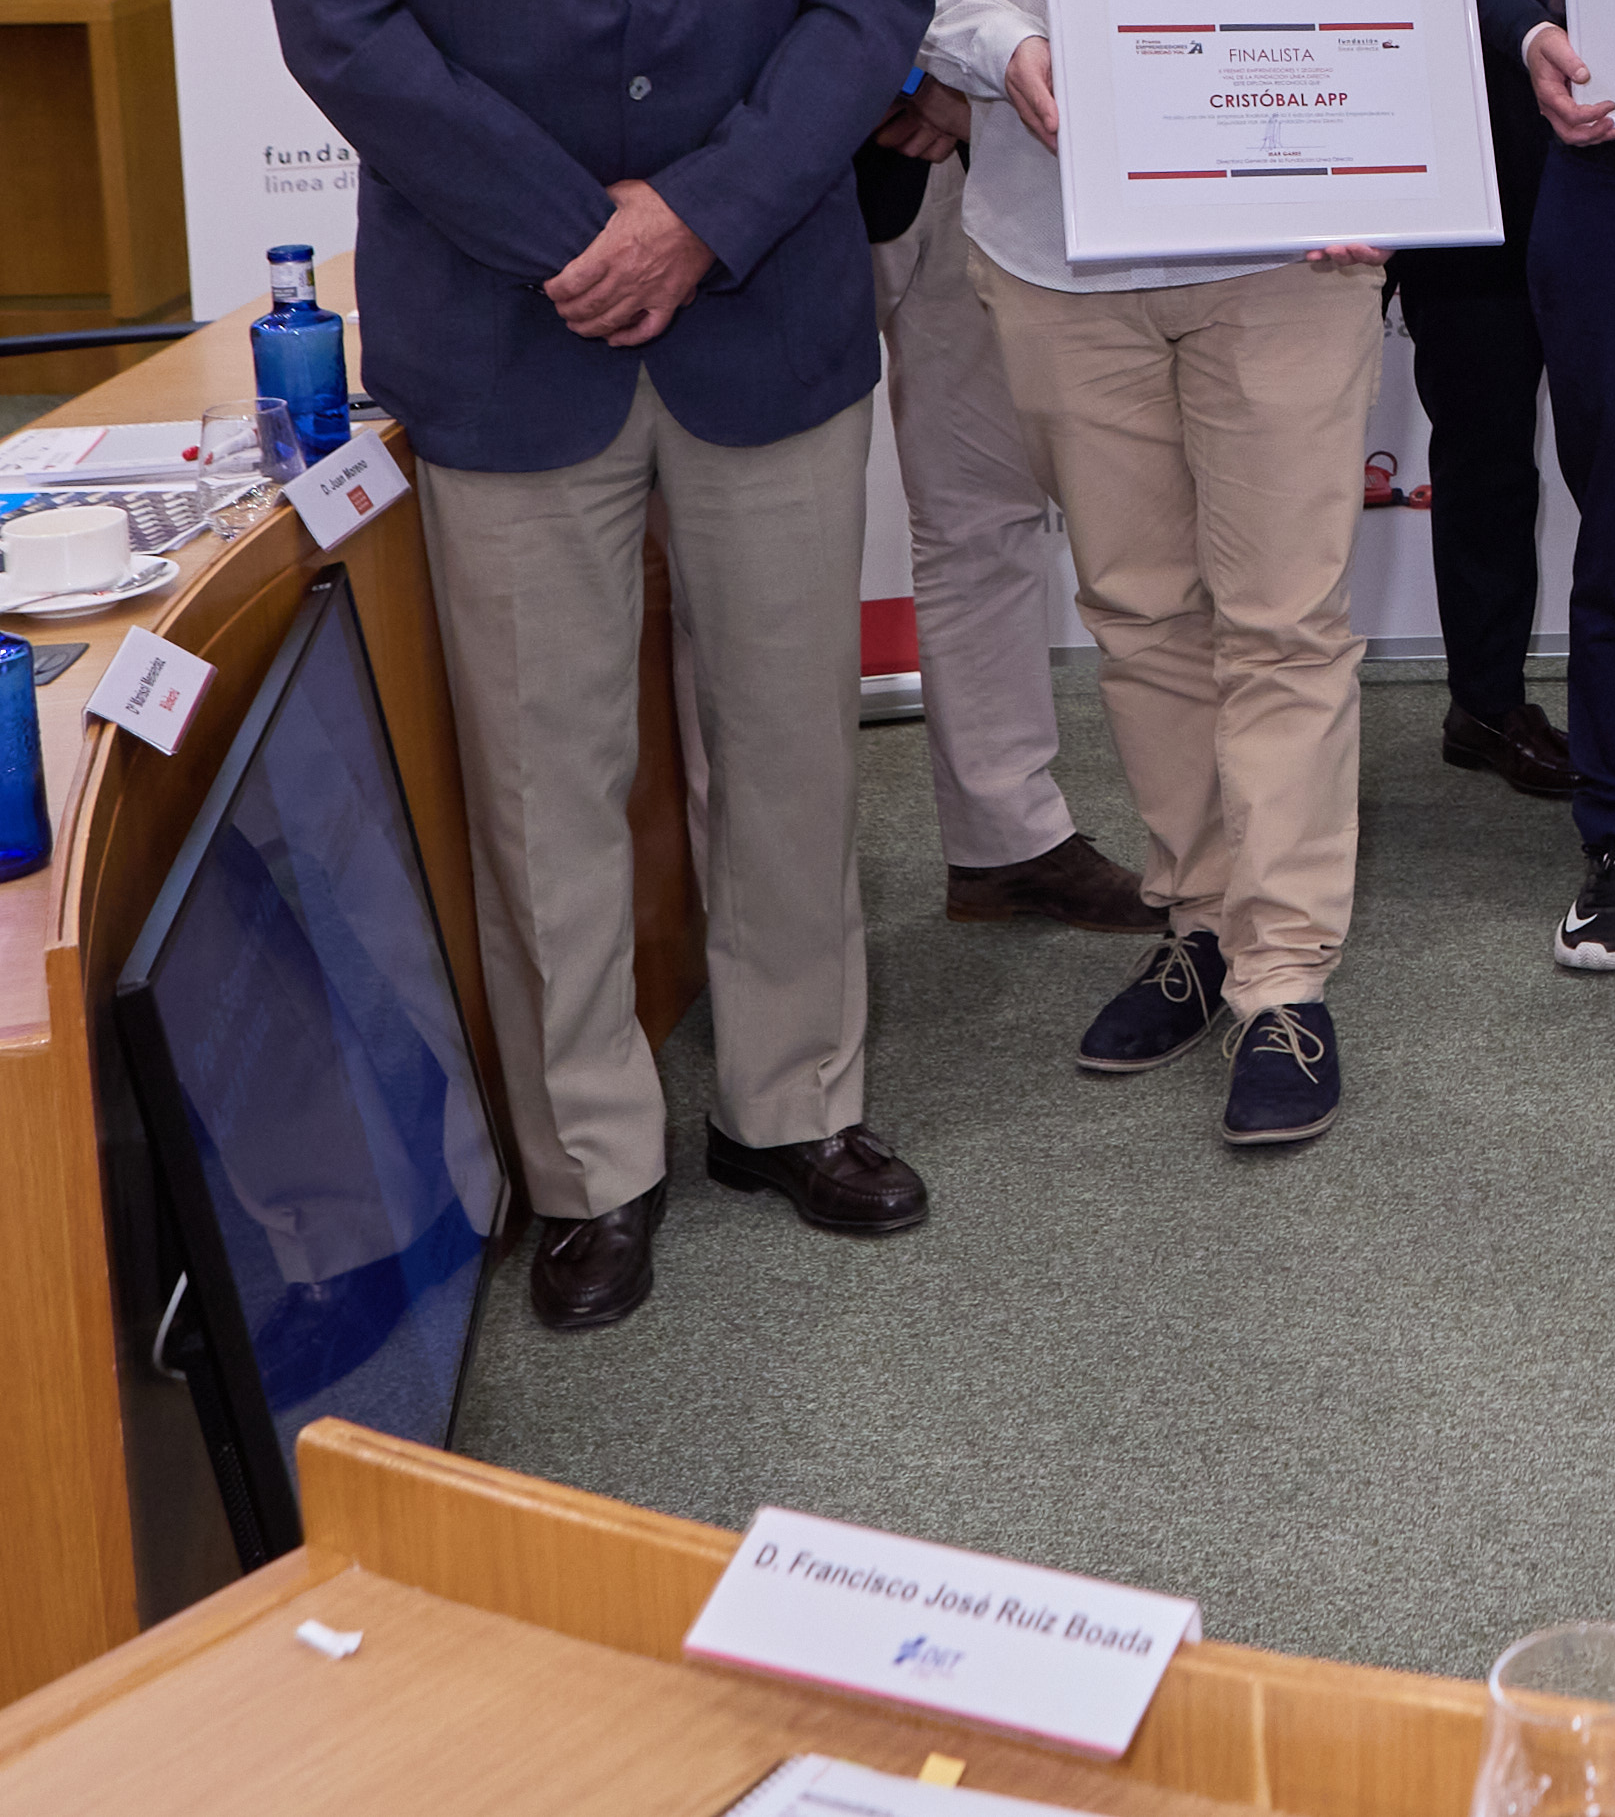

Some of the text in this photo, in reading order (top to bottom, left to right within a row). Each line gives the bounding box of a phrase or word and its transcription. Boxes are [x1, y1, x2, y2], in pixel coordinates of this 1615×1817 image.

[1230, 48, 1314, 62] FINALISTA
[1210, 89, 1347, 108] CRISTÓBAL APP
[264, 144, 359, 165] funda
[754, 1543, 1154, 1657] D. Francisco José Ruiz Boada
